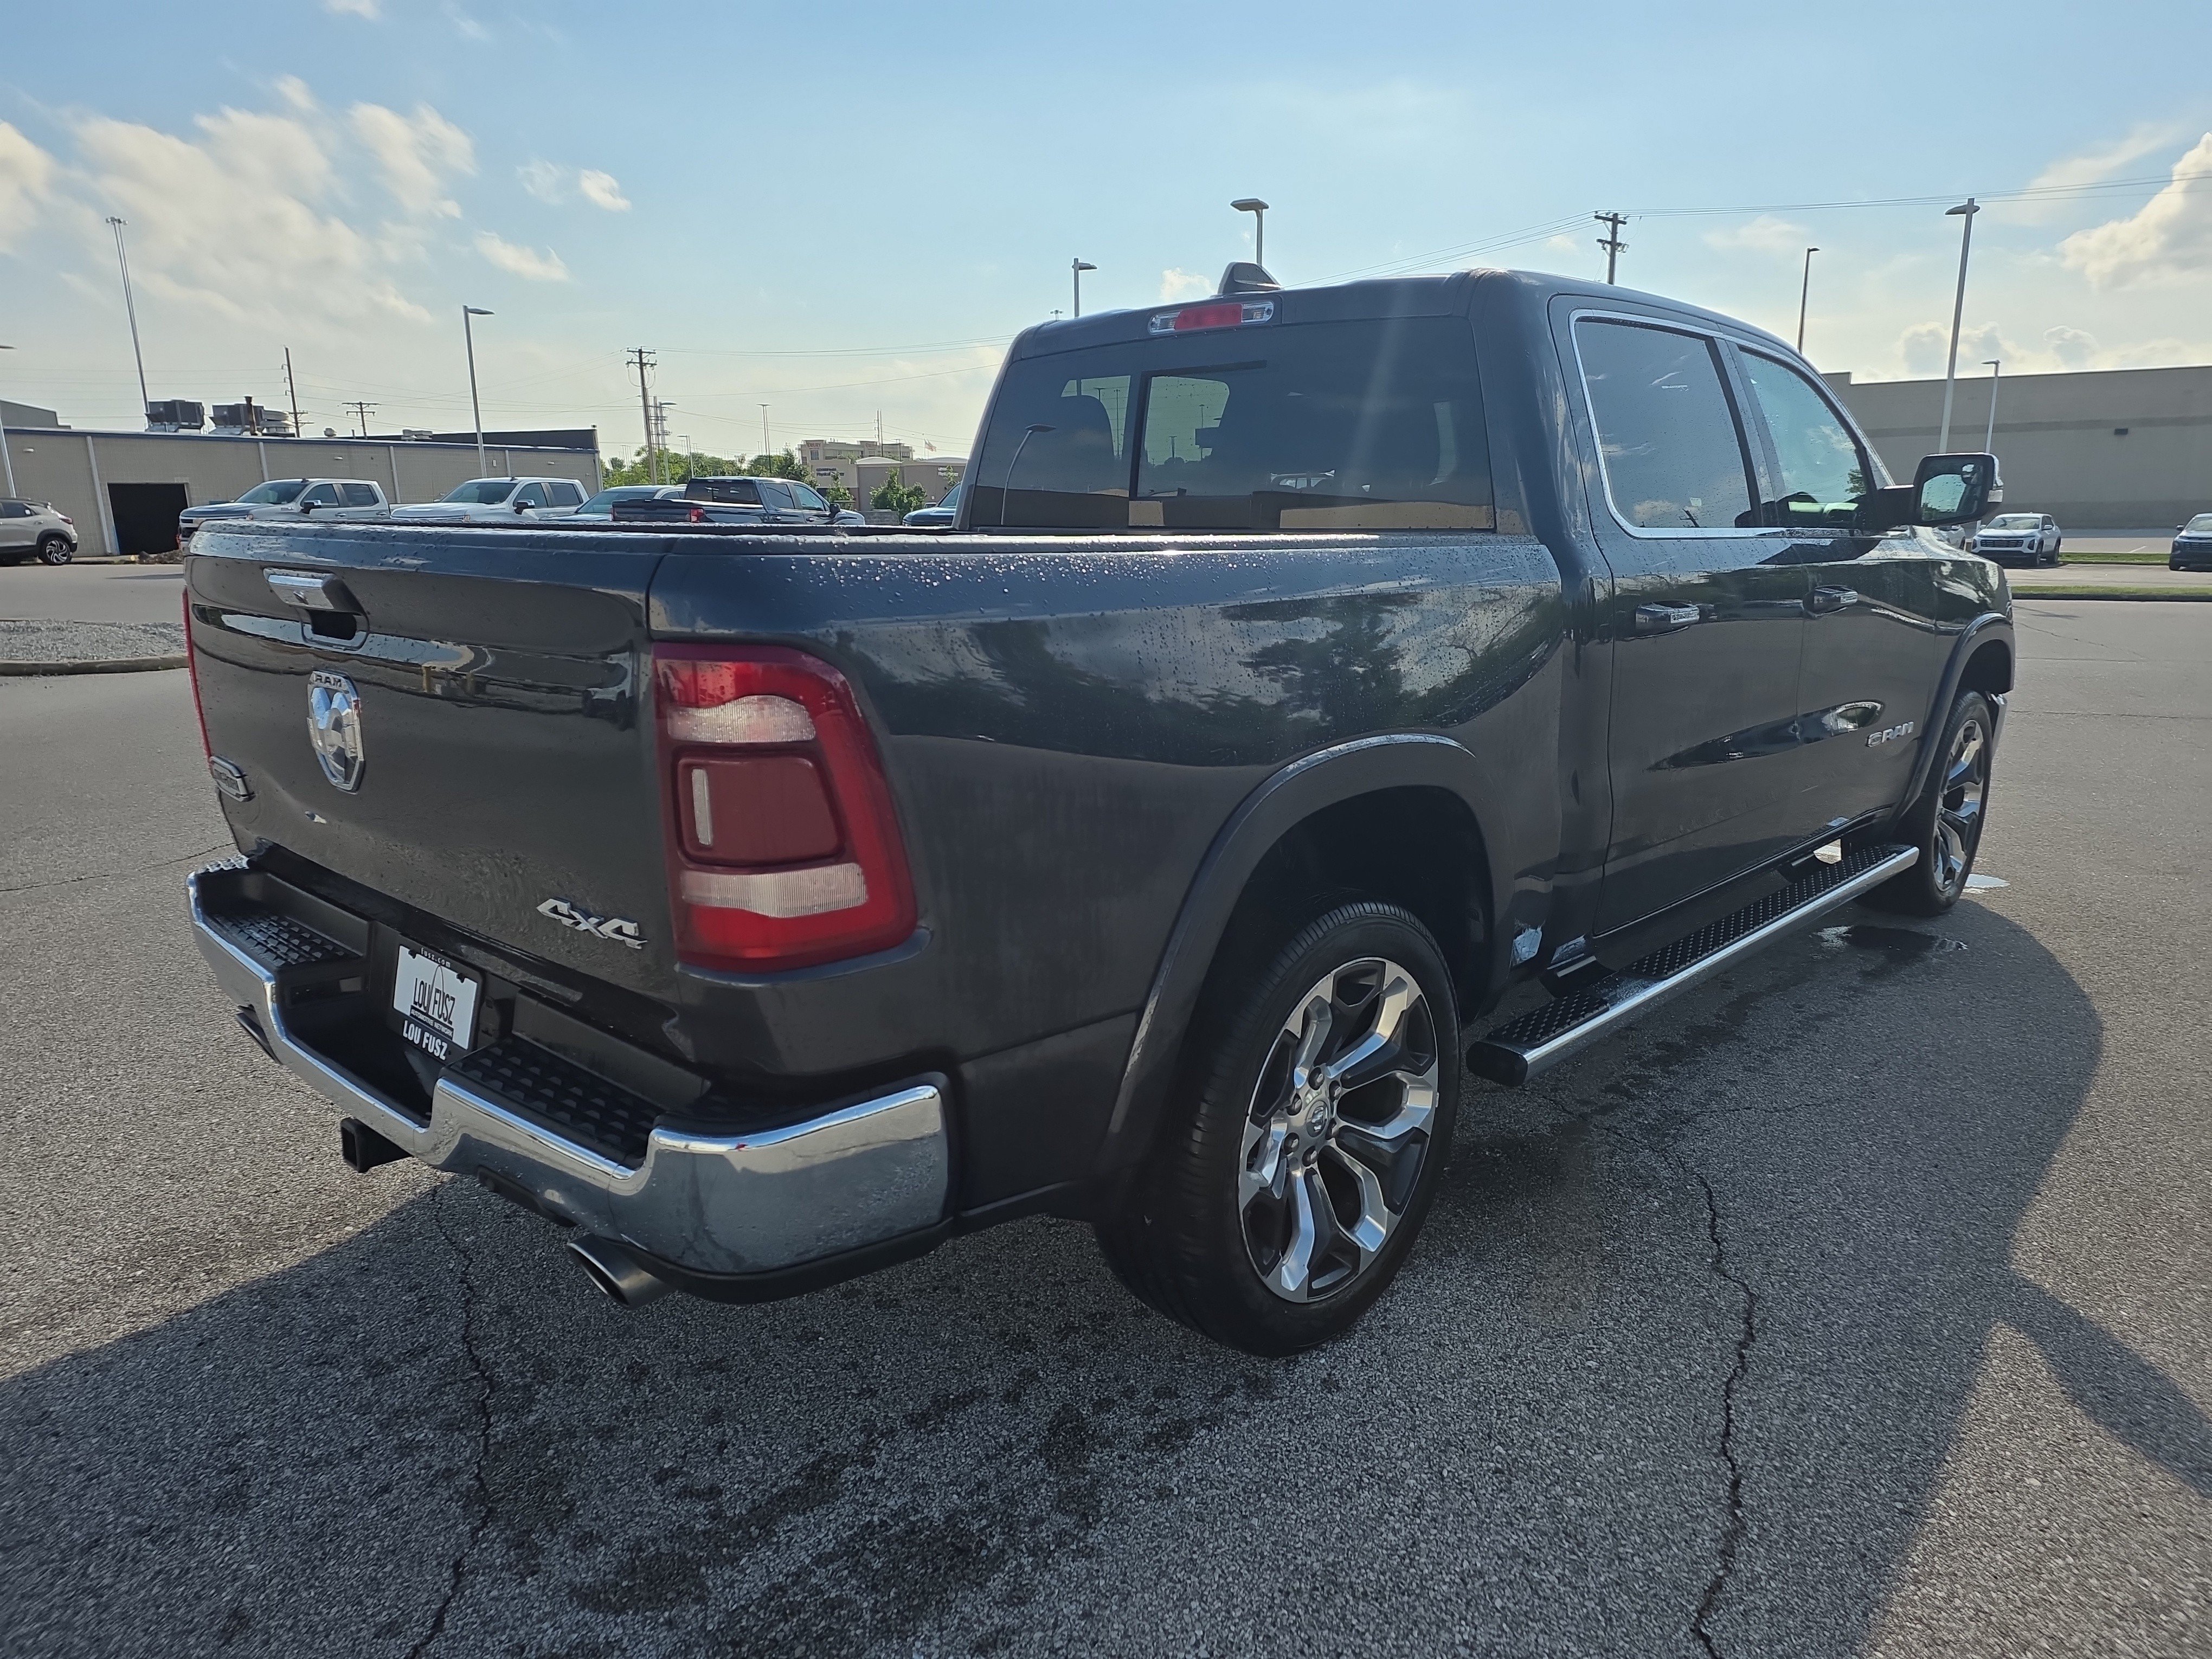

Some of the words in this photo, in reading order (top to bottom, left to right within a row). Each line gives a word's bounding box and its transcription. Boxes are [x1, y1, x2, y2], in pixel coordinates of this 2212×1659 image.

[315, 674, 342, 687] RAM
[1881, 721, 1914, 743] RAM
[421, 947, 451, 968] fusz.com
[413, 978, 431, 1012] LOU
[432, 987, 455, 1025] FUSZ
[434, 1021, 453, 1037] NETWORK
[403, 1020, 422, 1045] LOU
[422, 1031, 448, 1060] FUSZ
